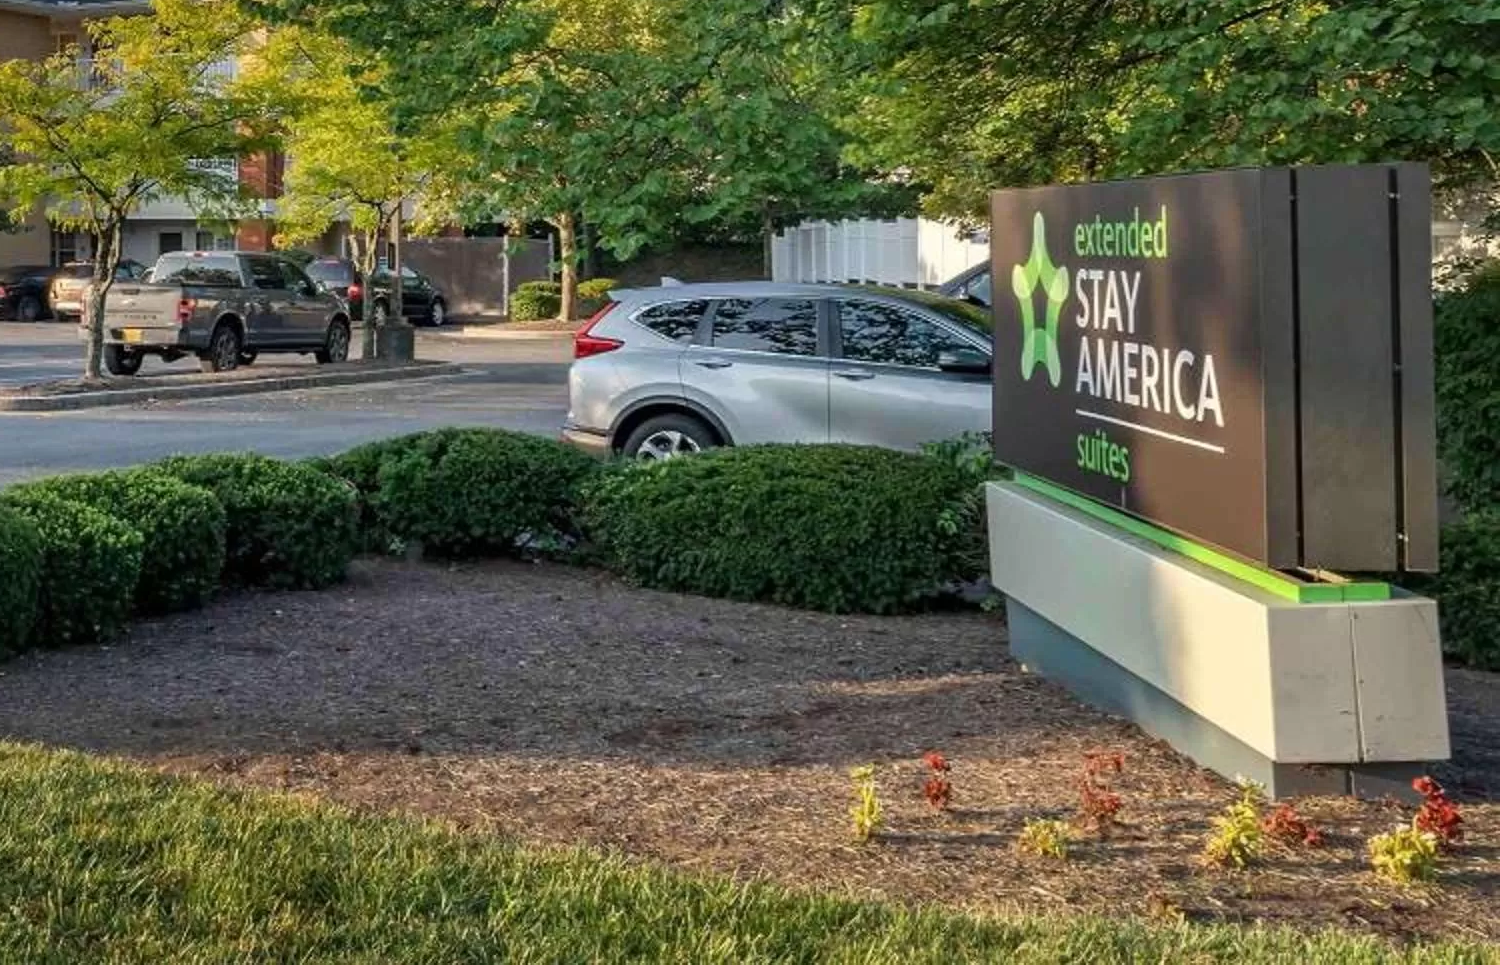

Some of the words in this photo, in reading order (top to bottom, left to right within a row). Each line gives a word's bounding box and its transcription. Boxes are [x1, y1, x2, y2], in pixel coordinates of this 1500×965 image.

[1075, 204, 1168, 258] extended
[1075, 268, 1141, 334] STAY
[1075, 336, 1225, 428] AMERICA
[1077, 429, 1130, 482] suites
